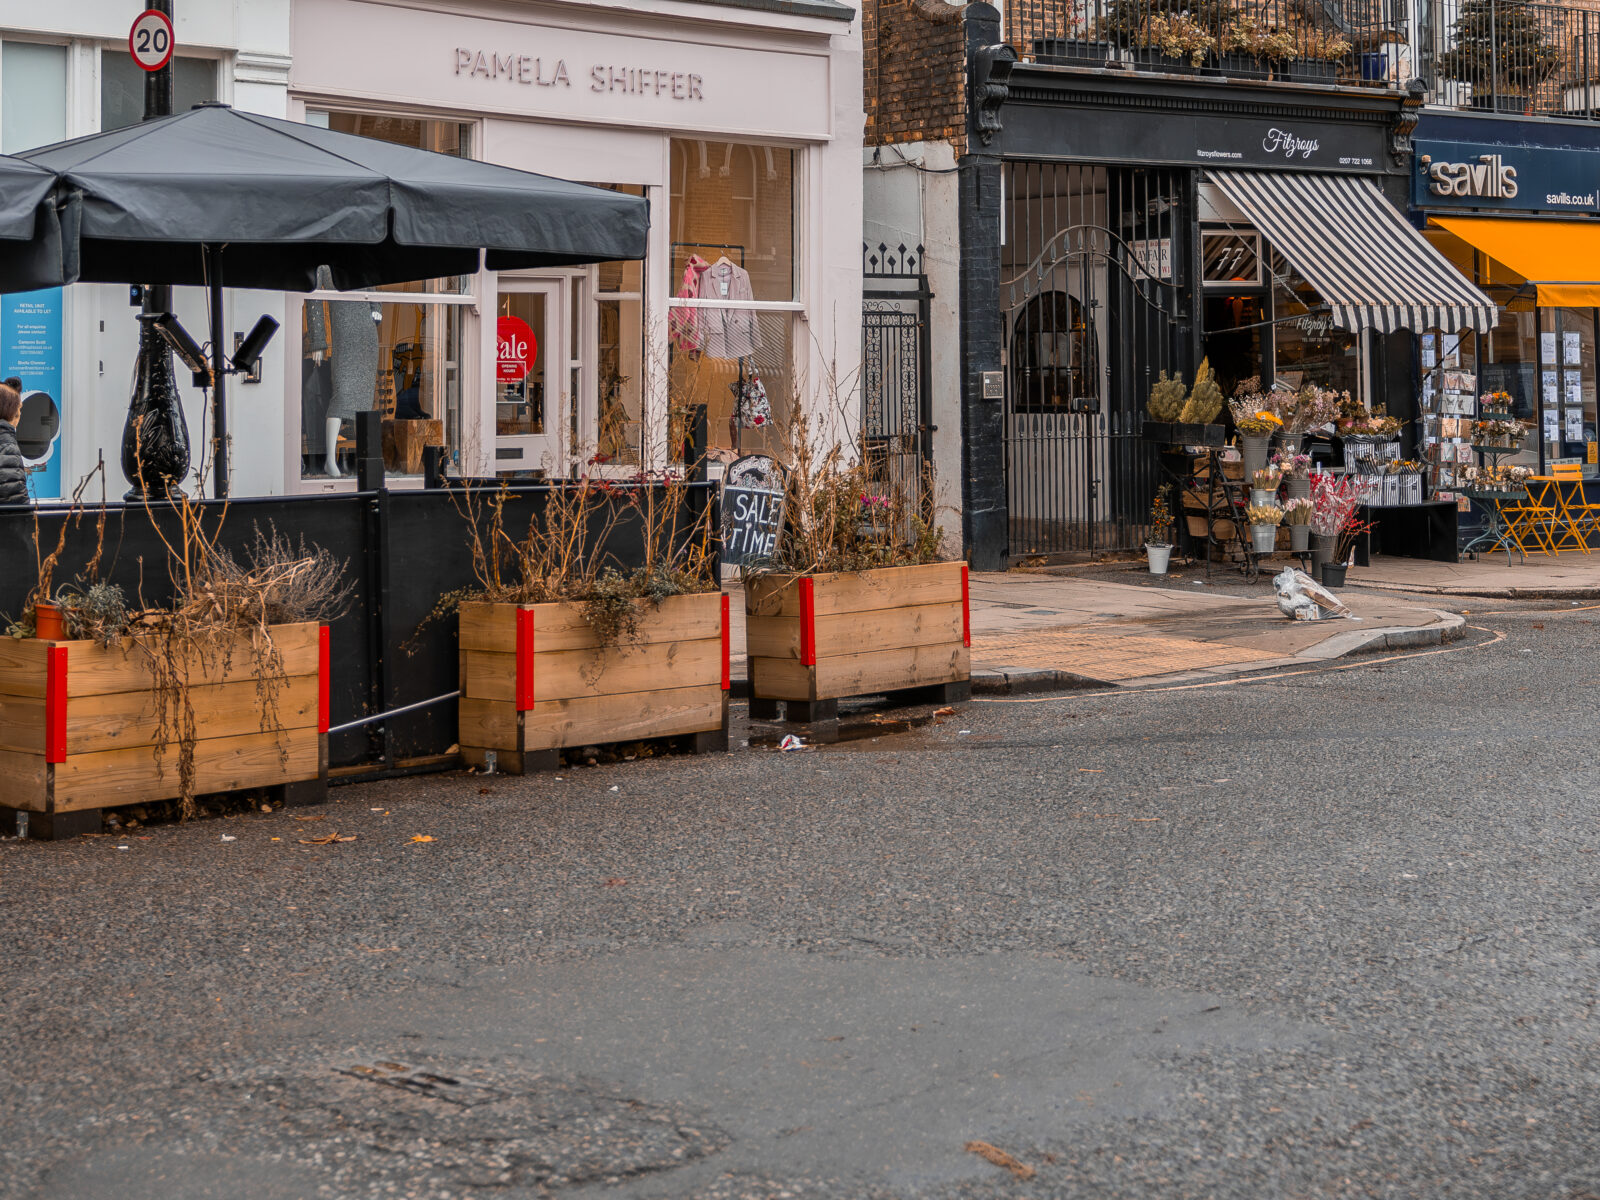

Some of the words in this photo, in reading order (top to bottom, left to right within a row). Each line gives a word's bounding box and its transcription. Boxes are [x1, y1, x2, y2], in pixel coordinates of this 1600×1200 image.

[137, 28, 168, 53] 20
[455, 47, 571, 87] PAMELA
[591, 63, 704, 101] SHIFFER
[1262, 127, 1320, 158] Fitzroys
[1351, 157, 1361, 165] 722
[1429, 154, 1518, 199] savills
[1546, 191, 1595, 206] savills.co.uk
[1216, 247, 1245, 271] 77
[733, 494, 782, 526] SALE
[730, 522, 776, 556] TIME
